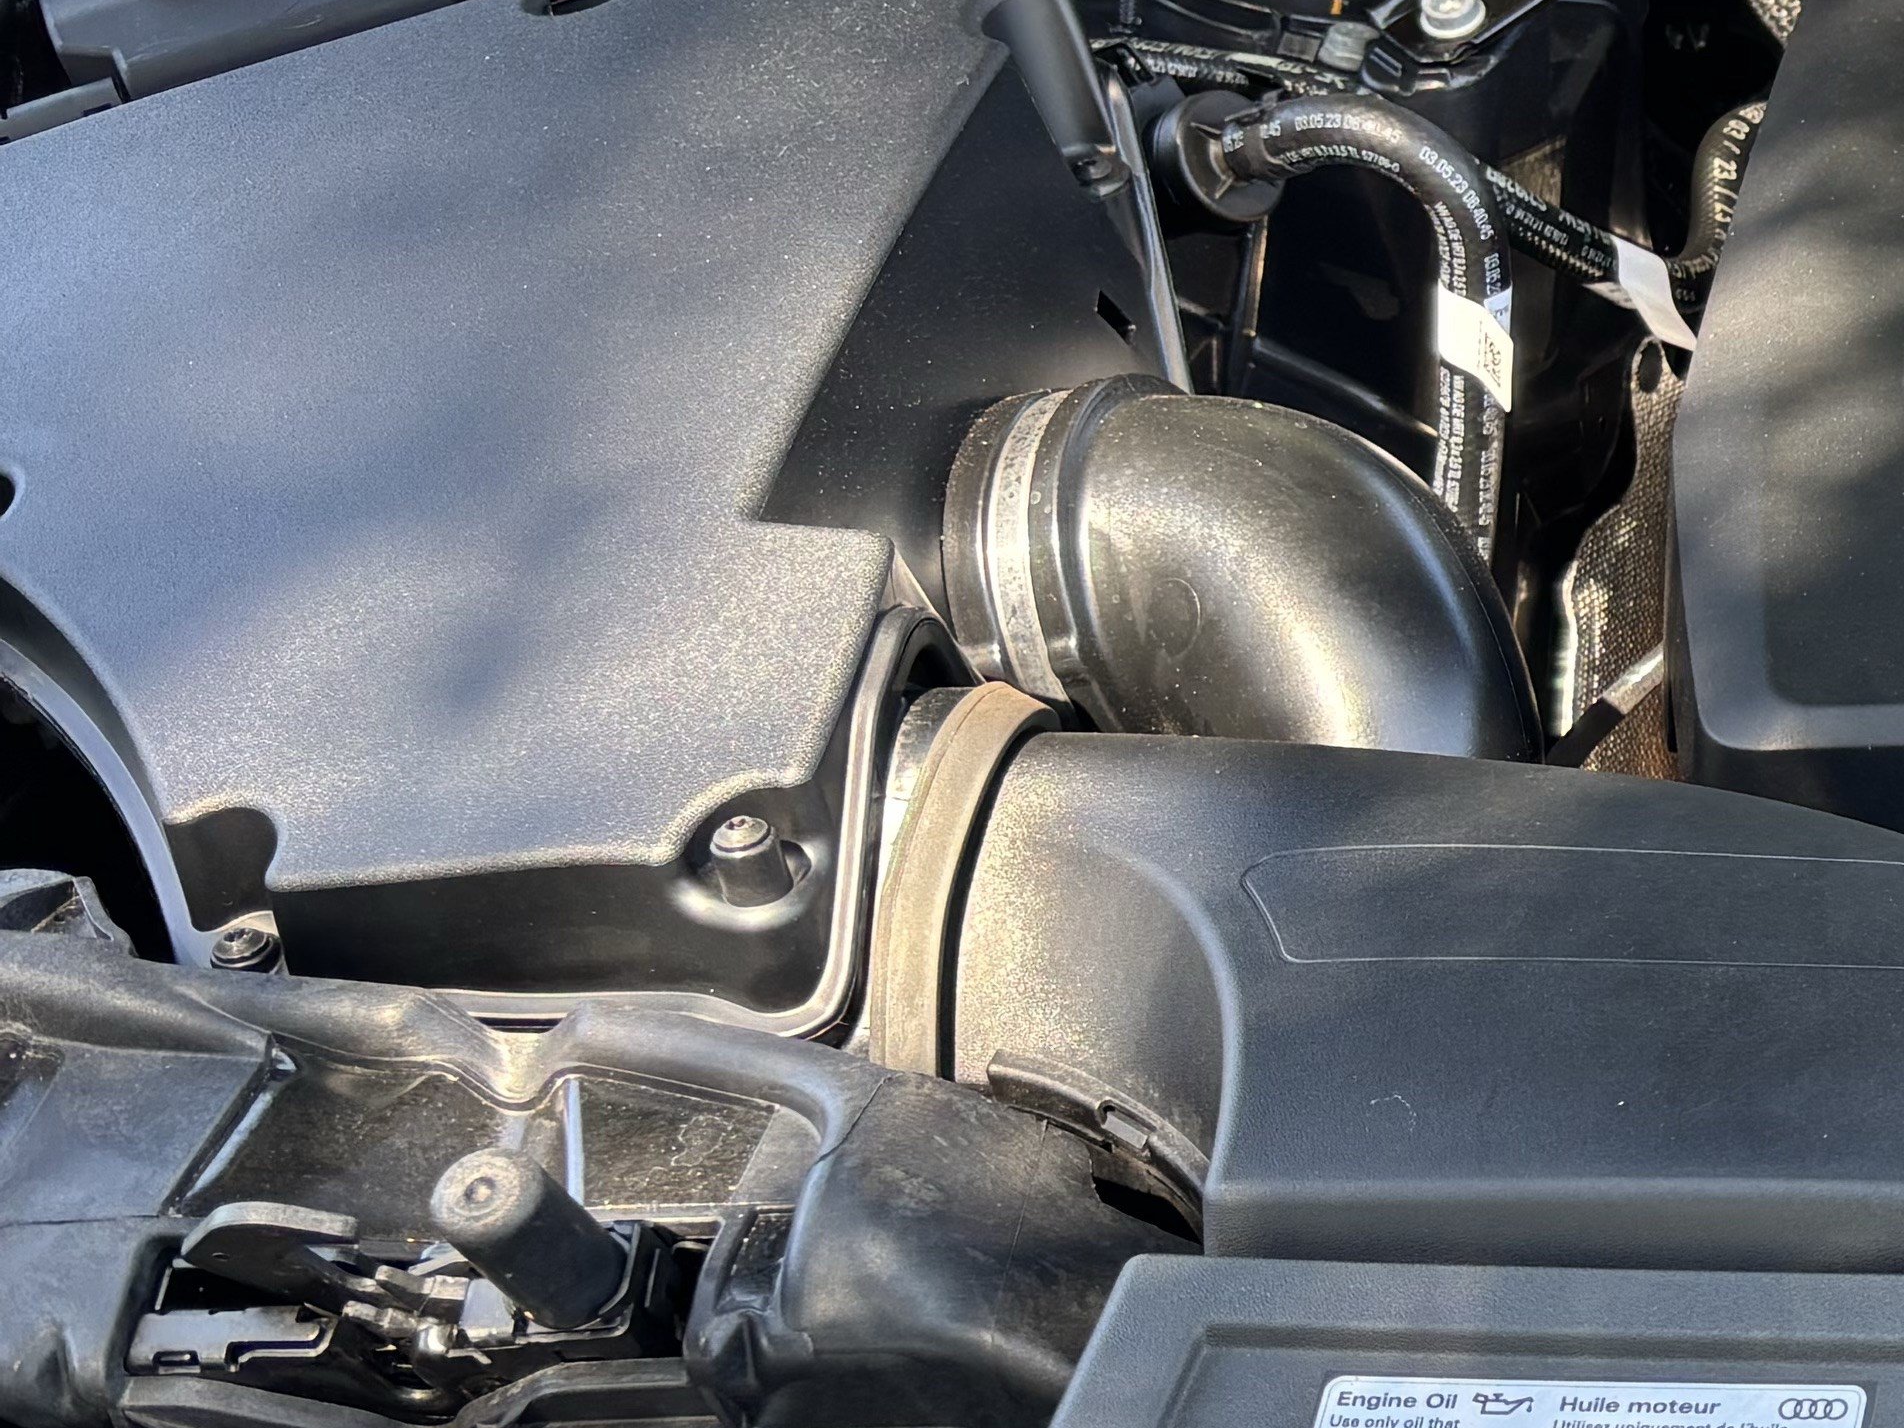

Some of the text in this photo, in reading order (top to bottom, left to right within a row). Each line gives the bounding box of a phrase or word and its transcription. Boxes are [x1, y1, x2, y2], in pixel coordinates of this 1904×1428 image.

[1337, 1391, 1458, 1410] Engine Oil
[1559, 1396, 1721, 1414] Huile moteur
[1330, 1414, 1360, 1428] Use
[1404, 1417, 1424, 1428] oil
